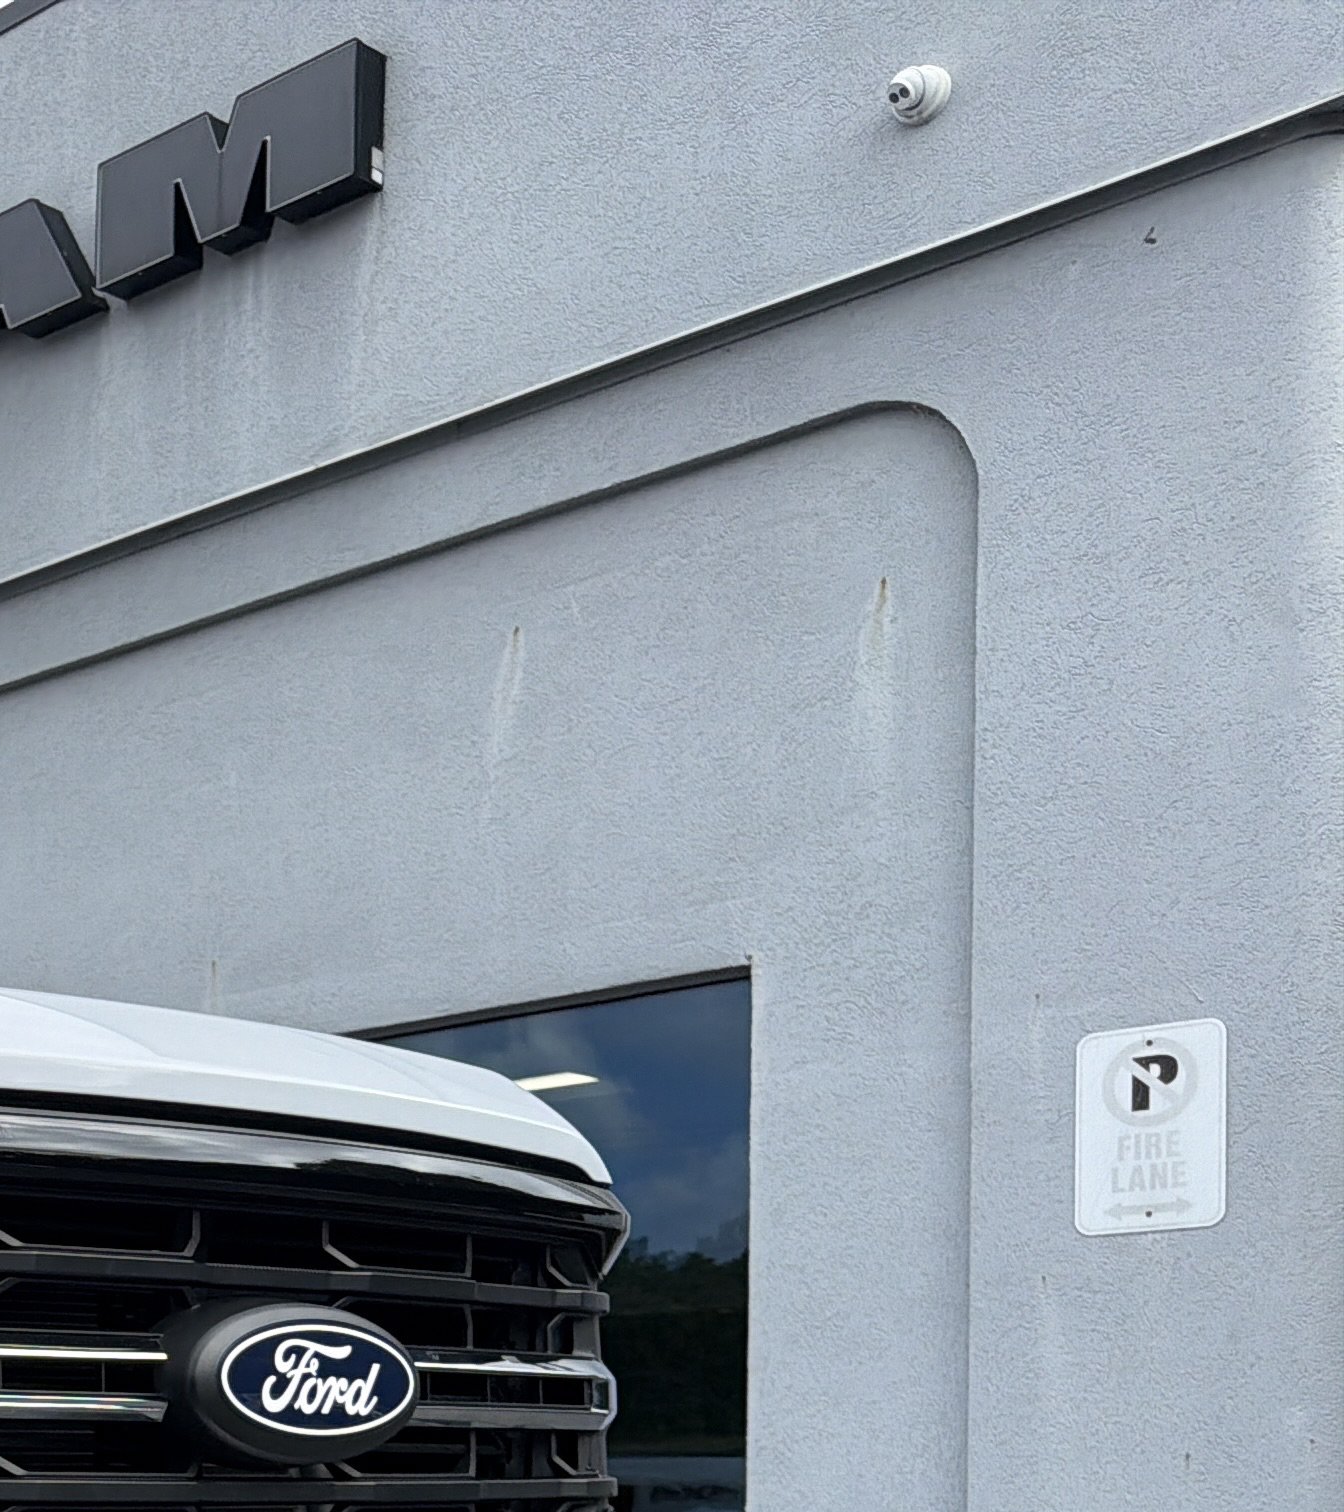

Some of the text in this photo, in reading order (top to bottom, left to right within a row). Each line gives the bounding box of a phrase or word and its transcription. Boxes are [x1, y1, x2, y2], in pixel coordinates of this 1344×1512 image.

[1131, 1054, 1179, 1112] P
[1116, 1130, 1182, 1162] FIRE
[1110, 1160, 1187, 1194] LANE
[261, 1338, 381, 1416] Ford
